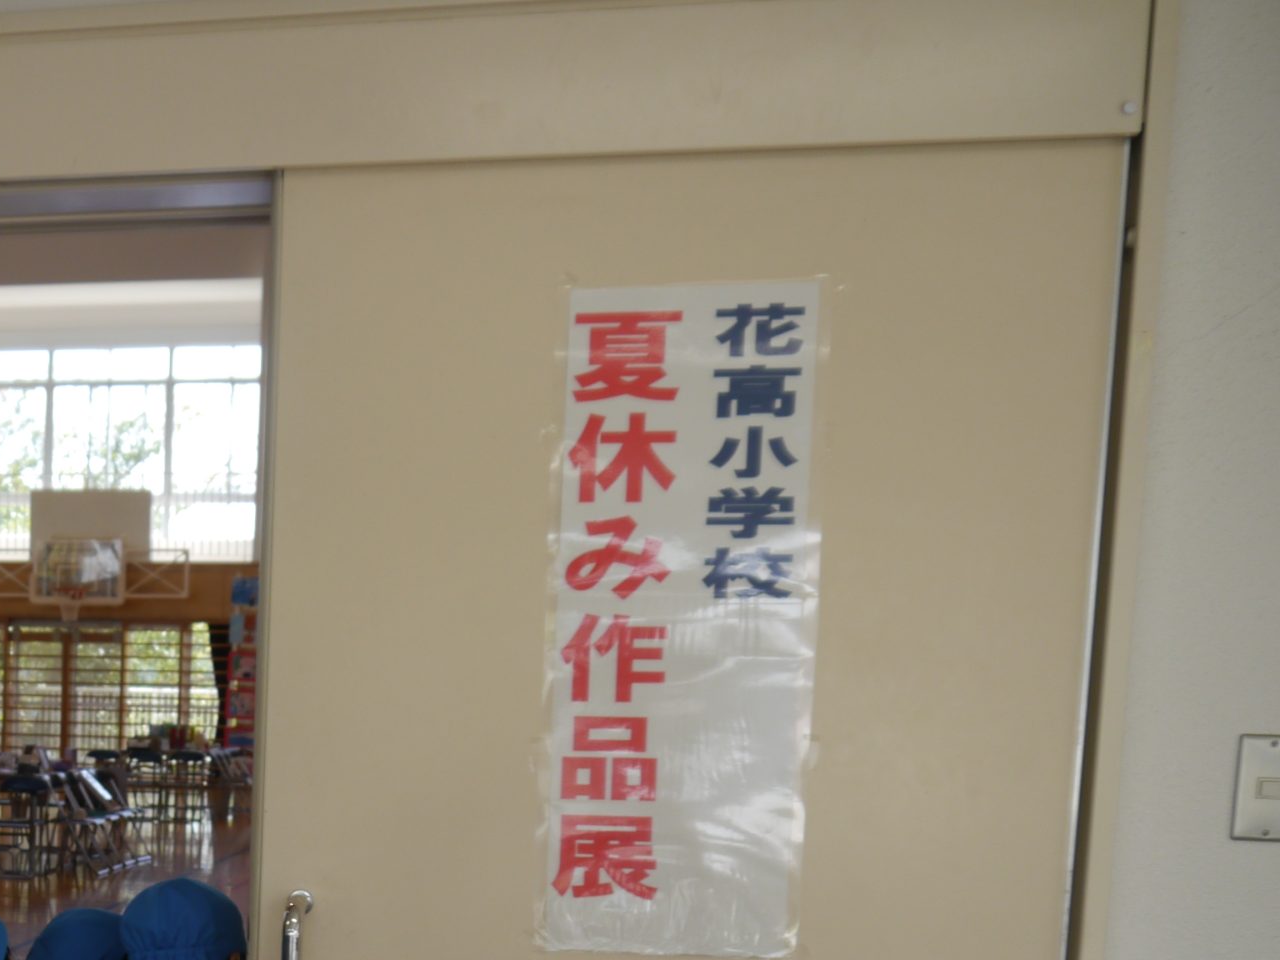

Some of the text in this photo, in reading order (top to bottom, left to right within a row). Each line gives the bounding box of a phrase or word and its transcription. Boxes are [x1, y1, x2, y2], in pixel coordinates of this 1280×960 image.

[551, 309, 684, 902] 夏休み作品展
[703, 303, 806, 600] 花高小学校
